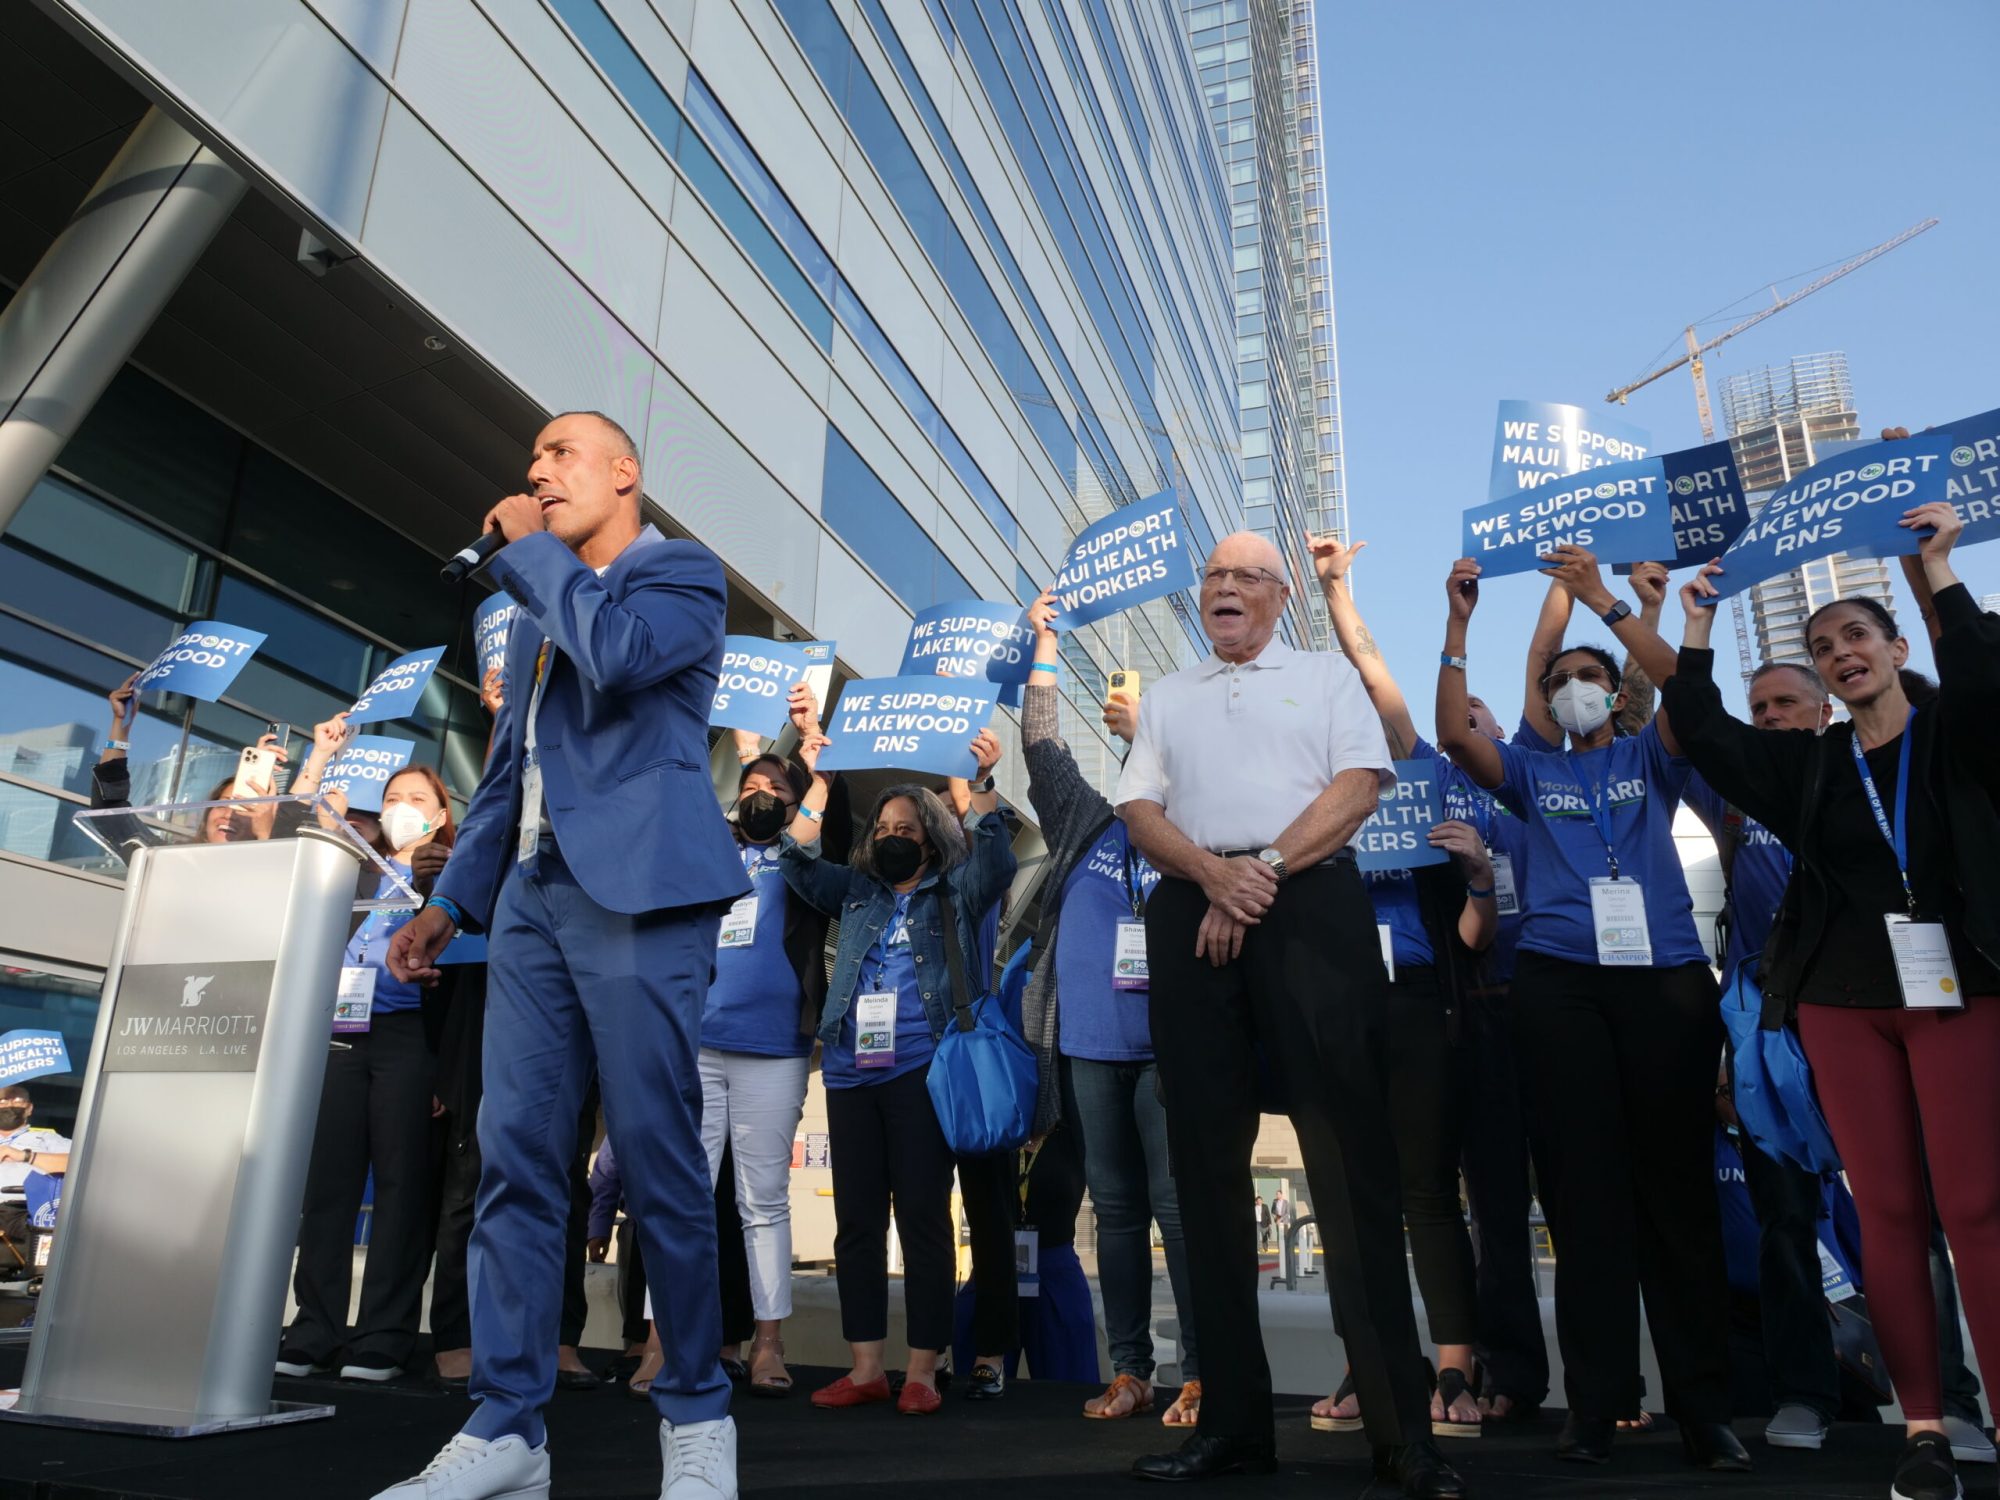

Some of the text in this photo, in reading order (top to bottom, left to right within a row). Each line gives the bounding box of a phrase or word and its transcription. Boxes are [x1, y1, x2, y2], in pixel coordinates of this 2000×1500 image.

[1504, 421, 1648, 461] WE SPPORT
[1503, 445, 1559, 468] MAUI
[1770, 455, 1939, 515] SUPPORT
[1471, 514, 1511, 536] WE
[1519, 476, 1657, 523] SUPPORT
[1671, 494, 1736, 526] ALTH
[1075, 508, 1174, 560] SUPPORT
[1483, 500, 1647, 551] LAKEWOOD
[1775, 518, 1843, 556] RNS
[1095, 530, 1178, 575] HEALTH
[1060, 559, 1168, 612] WORKERS
[914, 617, 1036, 645] WE SUPPORT
[913, 637, 1021, 664] LAKEWOOD
[722, 653, 798, 682] PPORT
[936, 656, 977, 677] RNS
[718, 673, 778, 697] WOOD
[843, 693, 988, 715] WE SUPPORT
[843, 714, 969, 733] LAKEWOOD
[873, 736, 920, 752] RNS
[319, 779, 350, 795] RNS
[1366, 805, 1432, 827] ALTH
[1357, 831, 1418, 852] KERS
[119, 1015, 255, 1037] JW MARRIOTT
[8, 1046, 63, 1063] HEALTH
[117, 1045, 248, 1056] LOS ANGELES L.A. LIVE
[0, 1057, 56, 1078] ORKERS
[1718, 1168, 1745, 1183] UN
